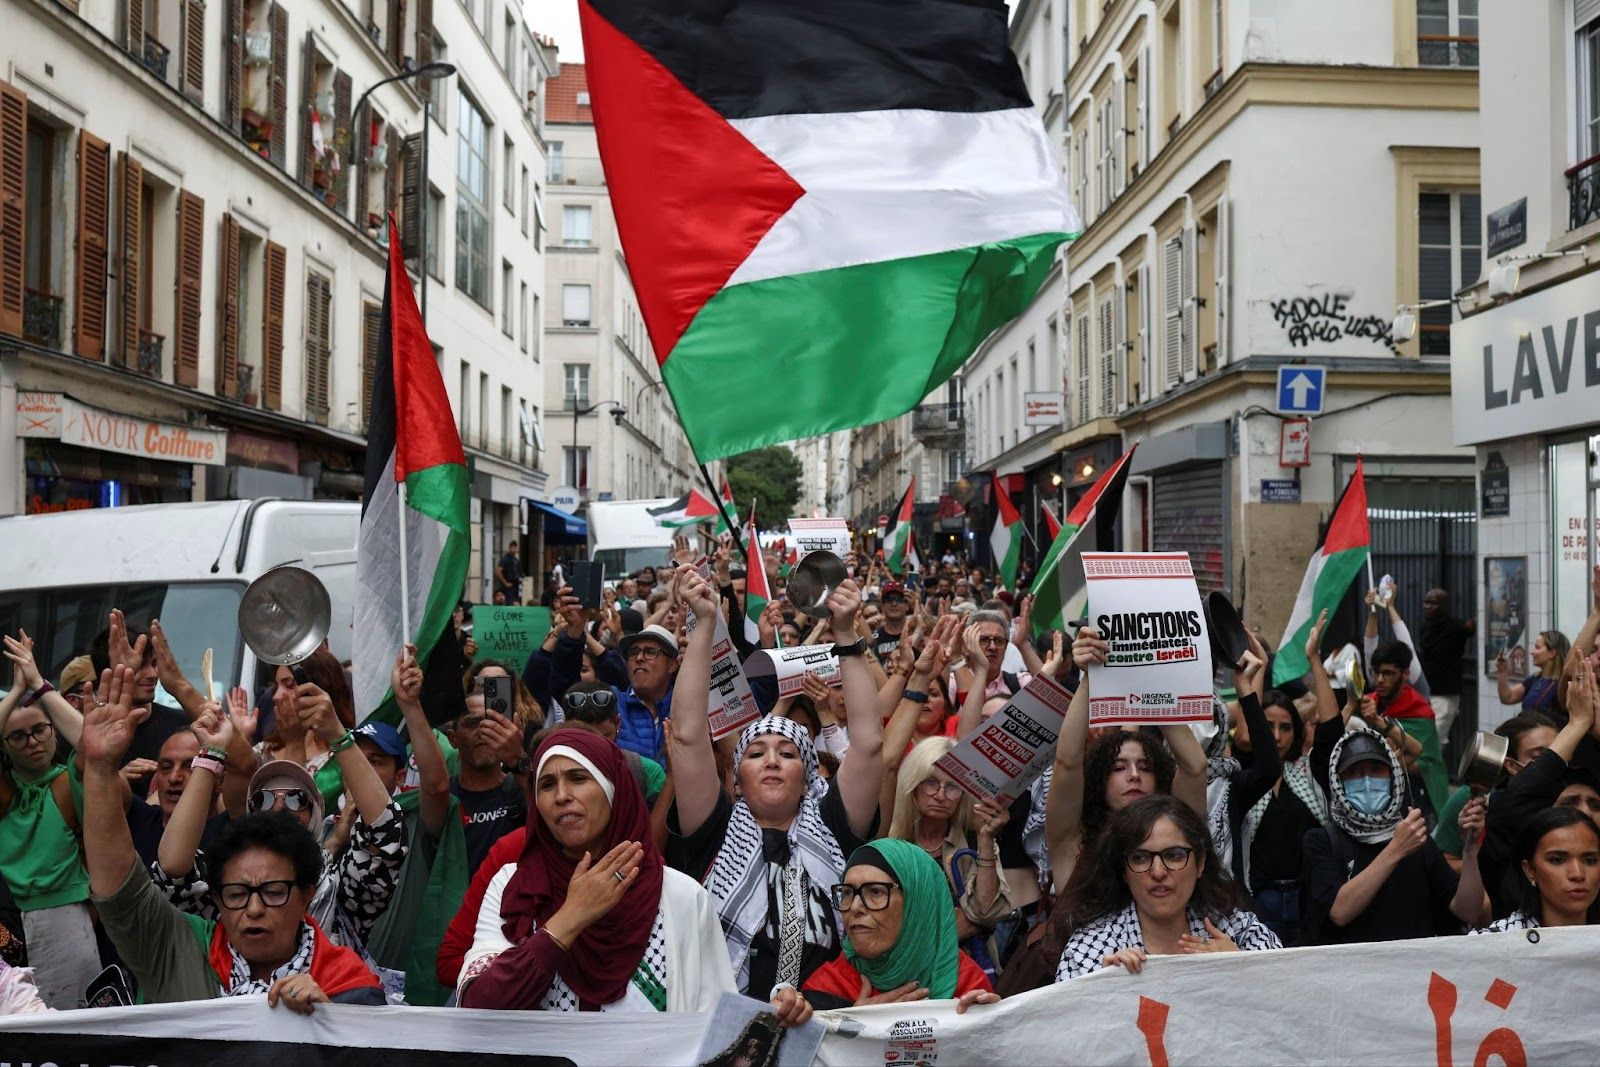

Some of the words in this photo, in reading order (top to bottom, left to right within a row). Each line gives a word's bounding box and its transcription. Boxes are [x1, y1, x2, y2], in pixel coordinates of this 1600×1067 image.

[1483, 308, 1600, 411] LAVE
[24, 393, 57, 405] NOUR
[16, 404, 63, 414] Coiffure
[80, 411, 139, 451] NOUR
[144, 423, 215, 460] Coiffure
[555, 496, 574, 504] PAIN
[1568, 517, 1581, 530] EN
[1563, 535, 1574, 548] DE
[1097, 610, 1202, 642] SANCTIONS
[484, 632, 495, 641] LA
[499, 631, 528, 641] LUTTE
[804, 653, 828, 665] FRANCE
[1107, 652, 1154, 663] contre
[1156, 647, 1196, 661] Israël
[1141, 692, 1173, 700] URGENCE
[1007, 706, 1027, 724] FROM
[1038, 727, 1058, 742] RIVER
[1005, 720, 1017, 732] TO
[1015, 728, 1031, 741] THE
[1029, 735, 1043, 748] SEA
[986, 726, 1034, 762] PALESTINE
[974, 737, 994, 755] WILL
[992, 750, 1005, 764] BE
[1001, 757, 1023, 777] FREE
[469, 807, 508, 824] JONES
[895, 1020, 910, 1028] NON
